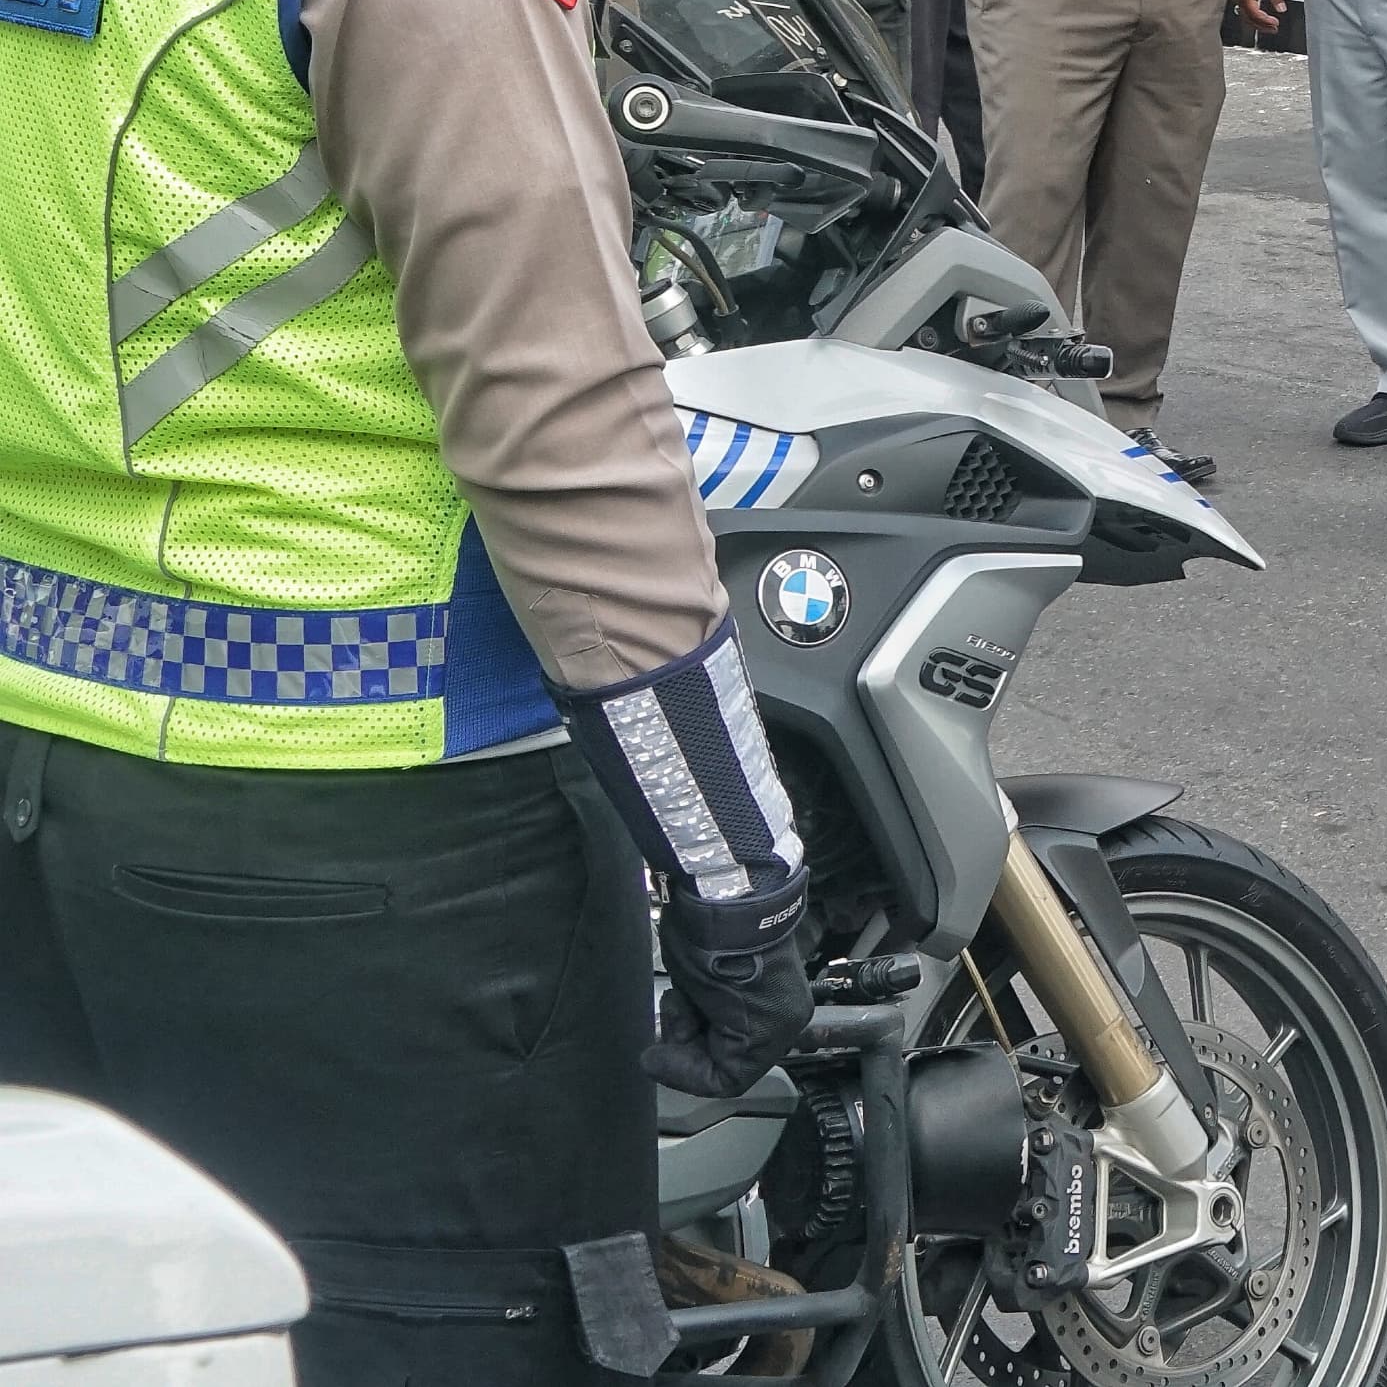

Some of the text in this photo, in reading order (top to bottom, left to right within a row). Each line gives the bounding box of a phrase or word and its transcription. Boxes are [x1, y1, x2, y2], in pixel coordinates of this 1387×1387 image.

[772, 553, 843, 588] BMW
[919, 647, 1007, 712] GS
[1064, 1164, 1083, 1254] brembo
